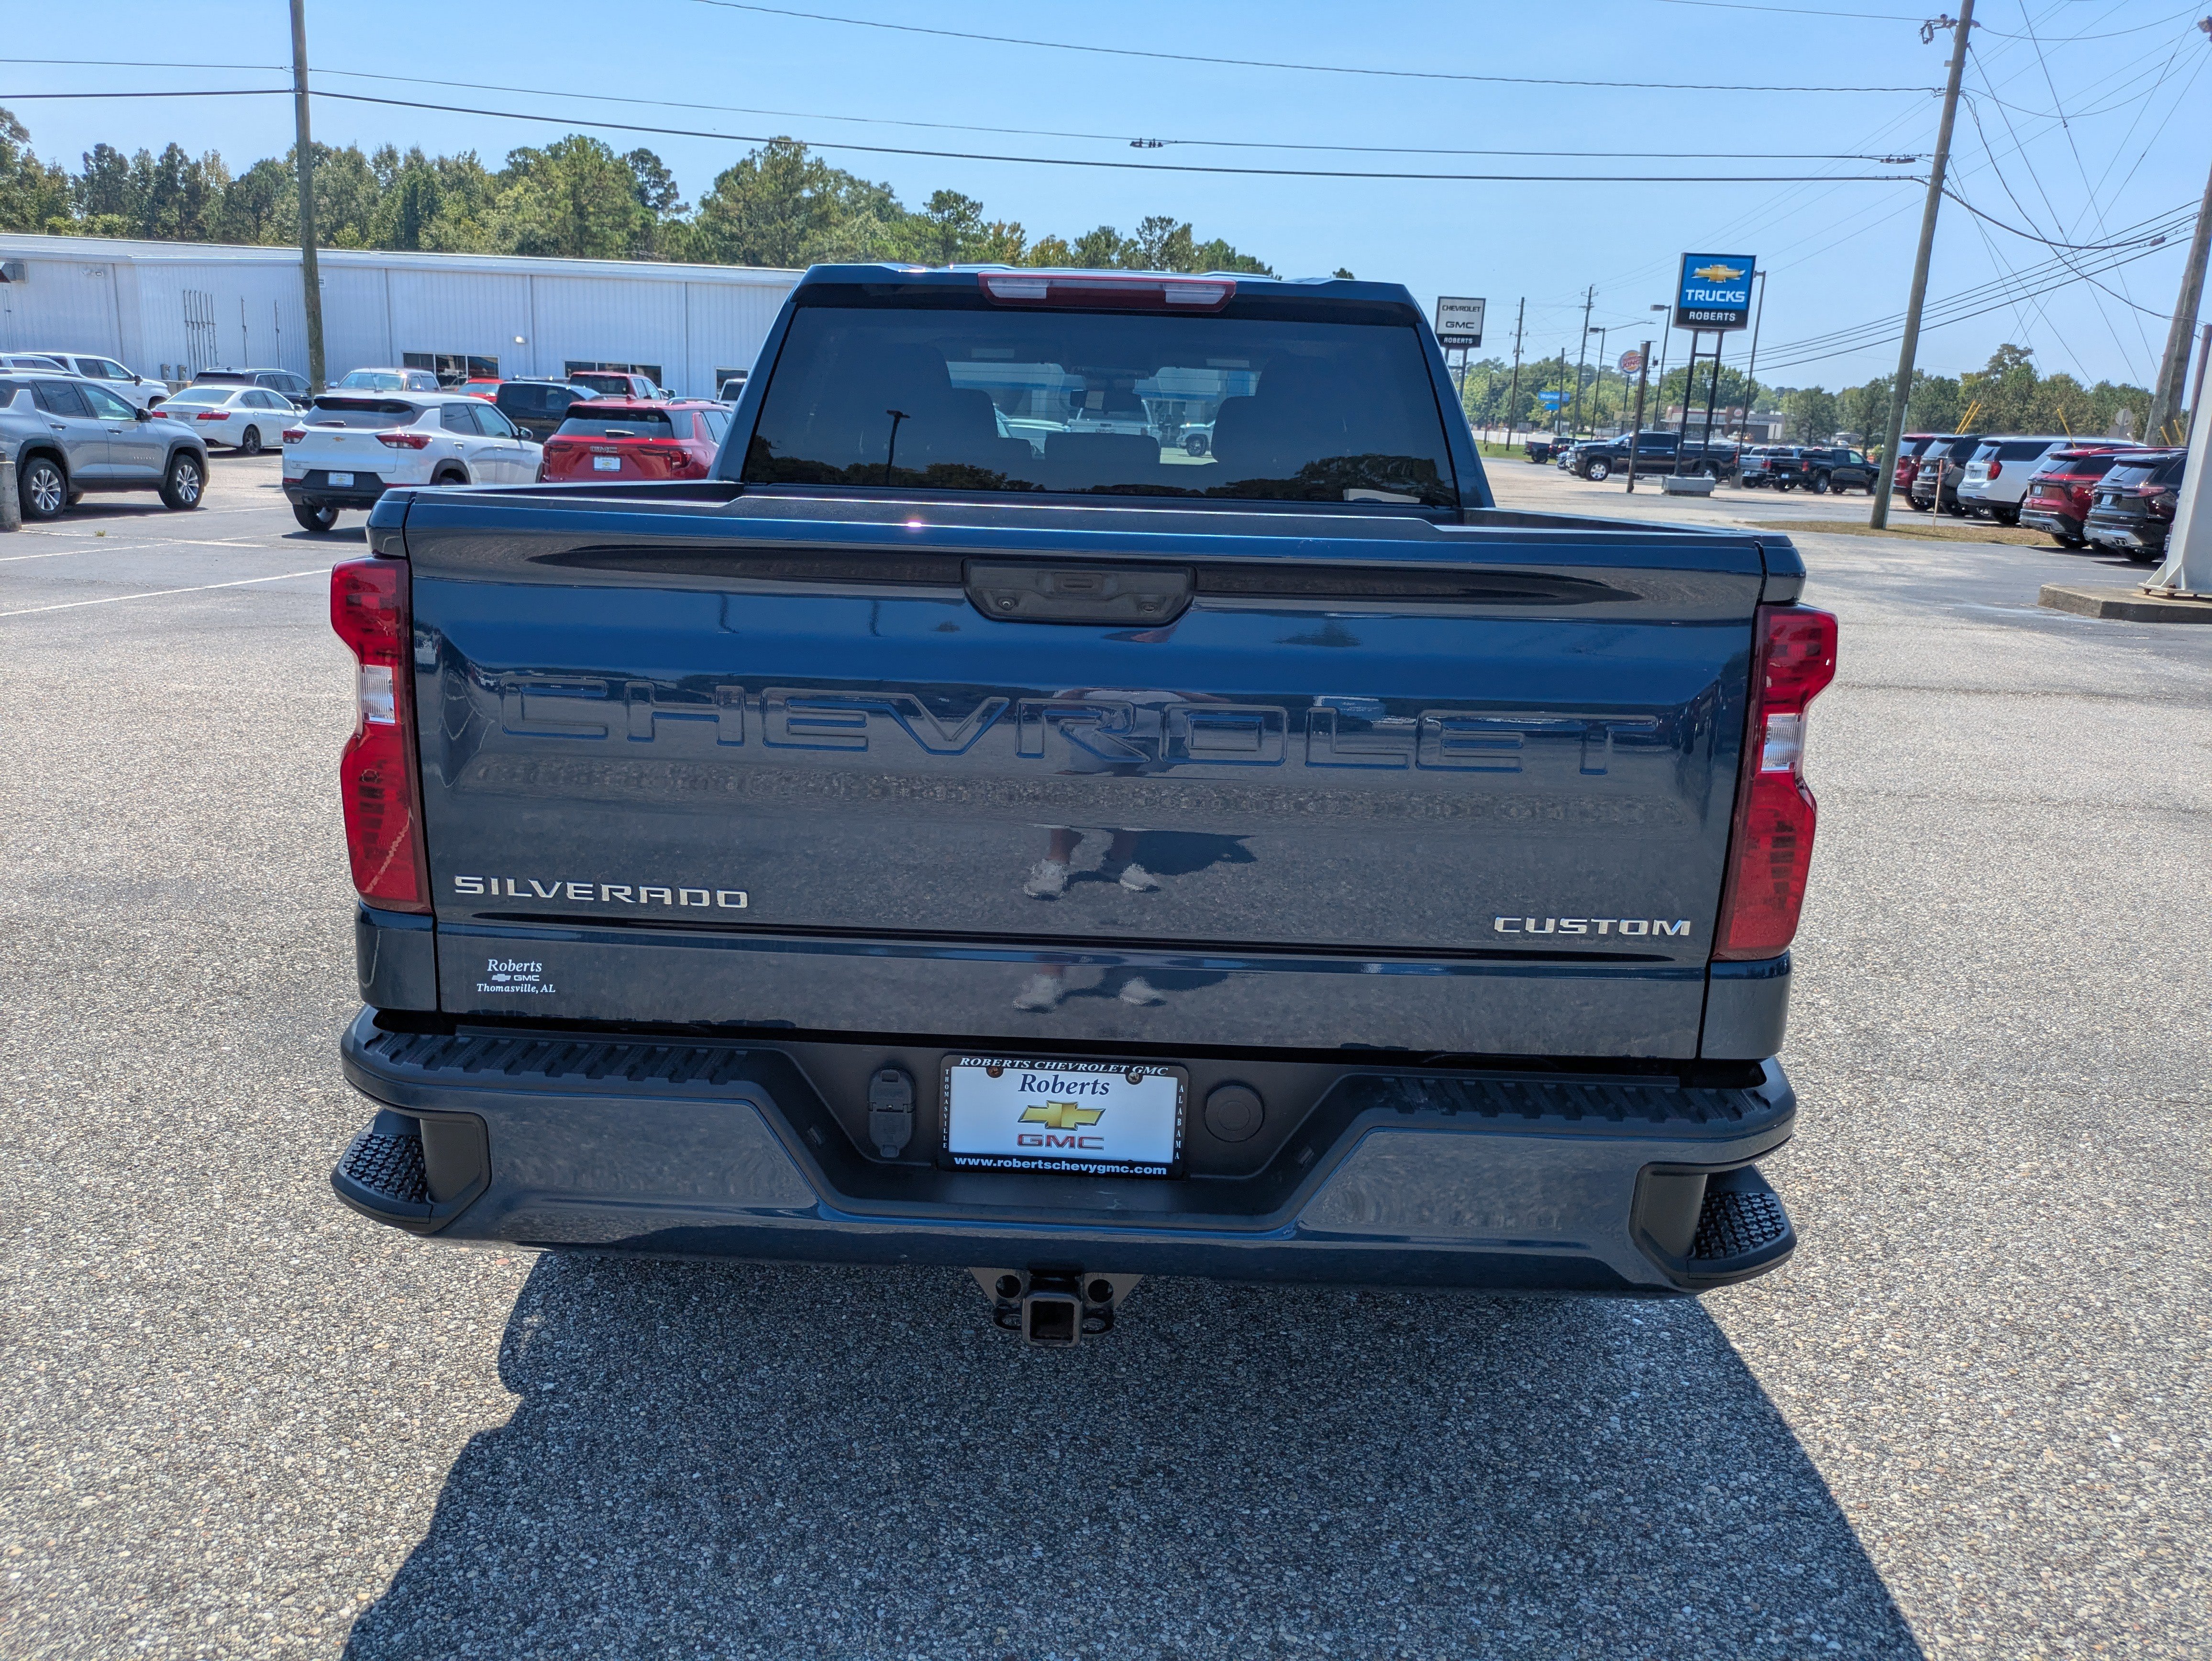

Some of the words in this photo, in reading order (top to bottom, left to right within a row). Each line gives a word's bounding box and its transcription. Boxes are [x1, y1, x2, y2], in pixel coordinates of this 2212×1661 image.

[1685, 289, 1745, 302] TRUCKS
[1446, 321, 1474, 329] GMC
[1689, 311, 1736, 321] ROBERTS
[500, 675, 1659, 775] CHEVROLET
[454, 875, 748, 908] SILVERADO
[1494, 917, 1691, 935] CUSTOM
[487, 959, 542, 972] Roberts
[476, 983, 538, 994] Thomasville,
[540, 984, 556, 993] AL
[959, 1057, 1031, 1068] ROBERTS
[1034, 1061, 1129, 1073] CHEVROLET
[1132, 1066, 1168, 1075] GMC
[1018, 1073, 1110, 1096] Roberts
[1174, 1085, 1184, 1160] ALABAMA
[1017, 1133, 1104, 1151] GMC
[954, 1157, 1167, 1175] www.robertschevygmc.com
